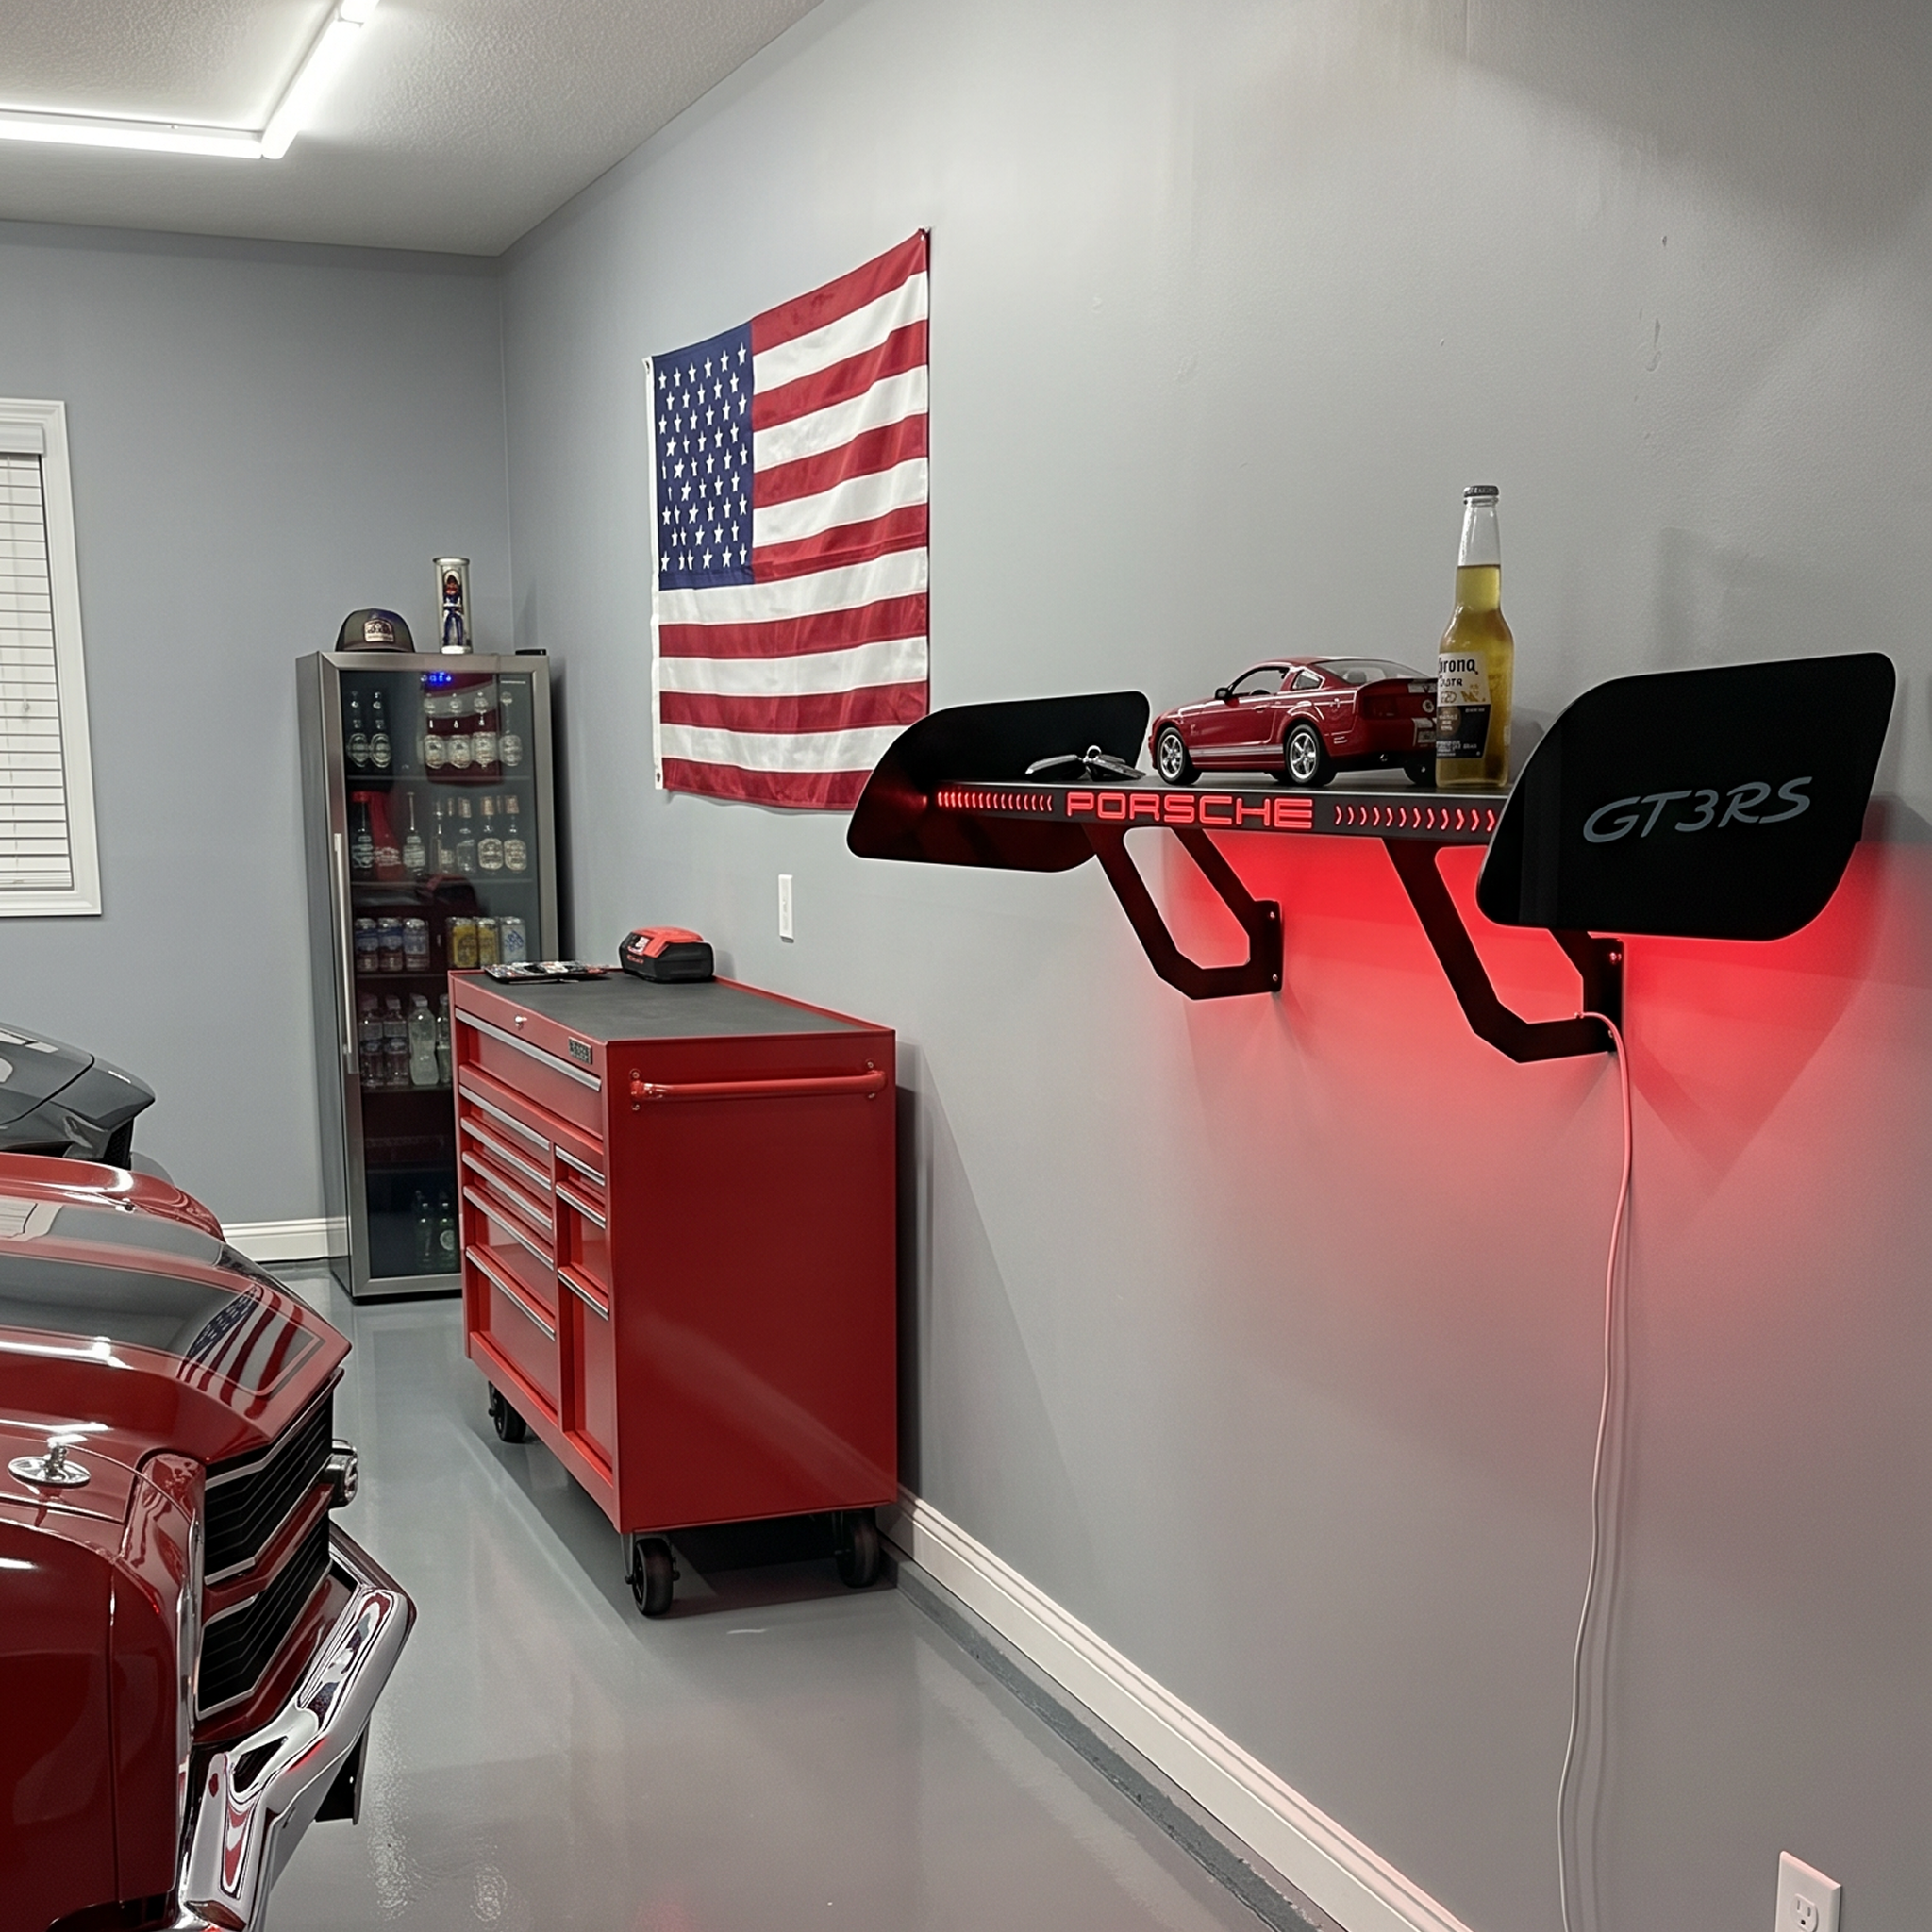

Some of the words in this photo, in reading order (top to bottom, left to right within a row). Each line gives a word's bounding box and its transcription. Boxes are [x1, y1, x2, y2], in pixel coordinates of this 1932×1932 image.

[1439, 657, 1479, 675] rona
[1067, 791, 1313, 829] PORSCHE
[1583, 776, 1812, 842] GT3RS
